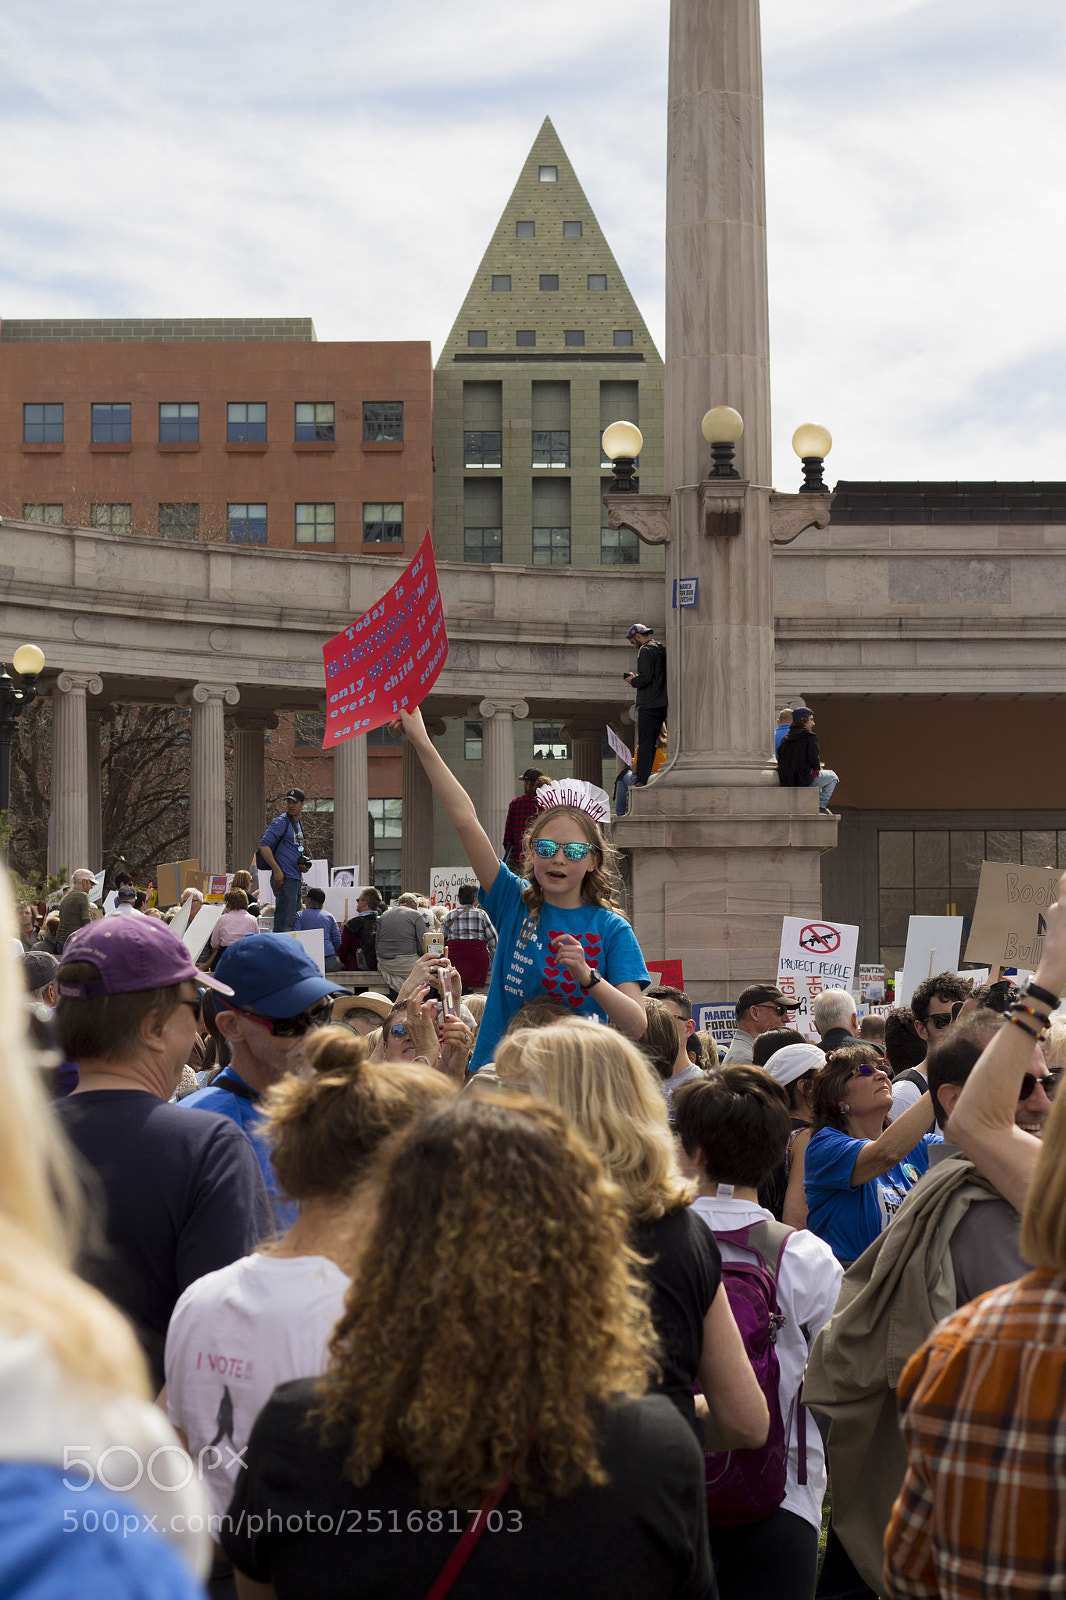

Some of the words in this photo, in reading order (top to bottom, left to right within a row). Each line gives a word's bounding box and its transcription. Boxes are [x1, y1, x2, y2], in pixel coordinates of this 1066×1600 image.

[345, 601, 385, 641] Today
[395, 585, 404, 600] is
[411, 553, 424, 578] my
[330, 677, 365, 703] only
[366, 631, 412, 682] WISH
[417, 615, 426, 632] is
[330, 689, 377, 719] every
[384, 656, 414, 691] child
[416, 638, 431, 660] can
[334, 718, 371, 738] safe
[392, 695, 409, 713] in
[534, 788, 586, 812] BIRTHDAY
[584, 798, 608, 823] GIRL
[433, 874, 450, 888] Cory
[513, 950, 534, 965] those
[1004, 932, 1044, 965] Bull
[510, 962, 525, 974] who
[780, 958, 816, 974] PROTECT
[818, 961, 852, 979] PEOPLE
[506, 973, 523, 986] now
[504, 984, 524, 997] can't
[705, 1021, 726, 1031] FOR
[196, 1351, 203, 1371] I
